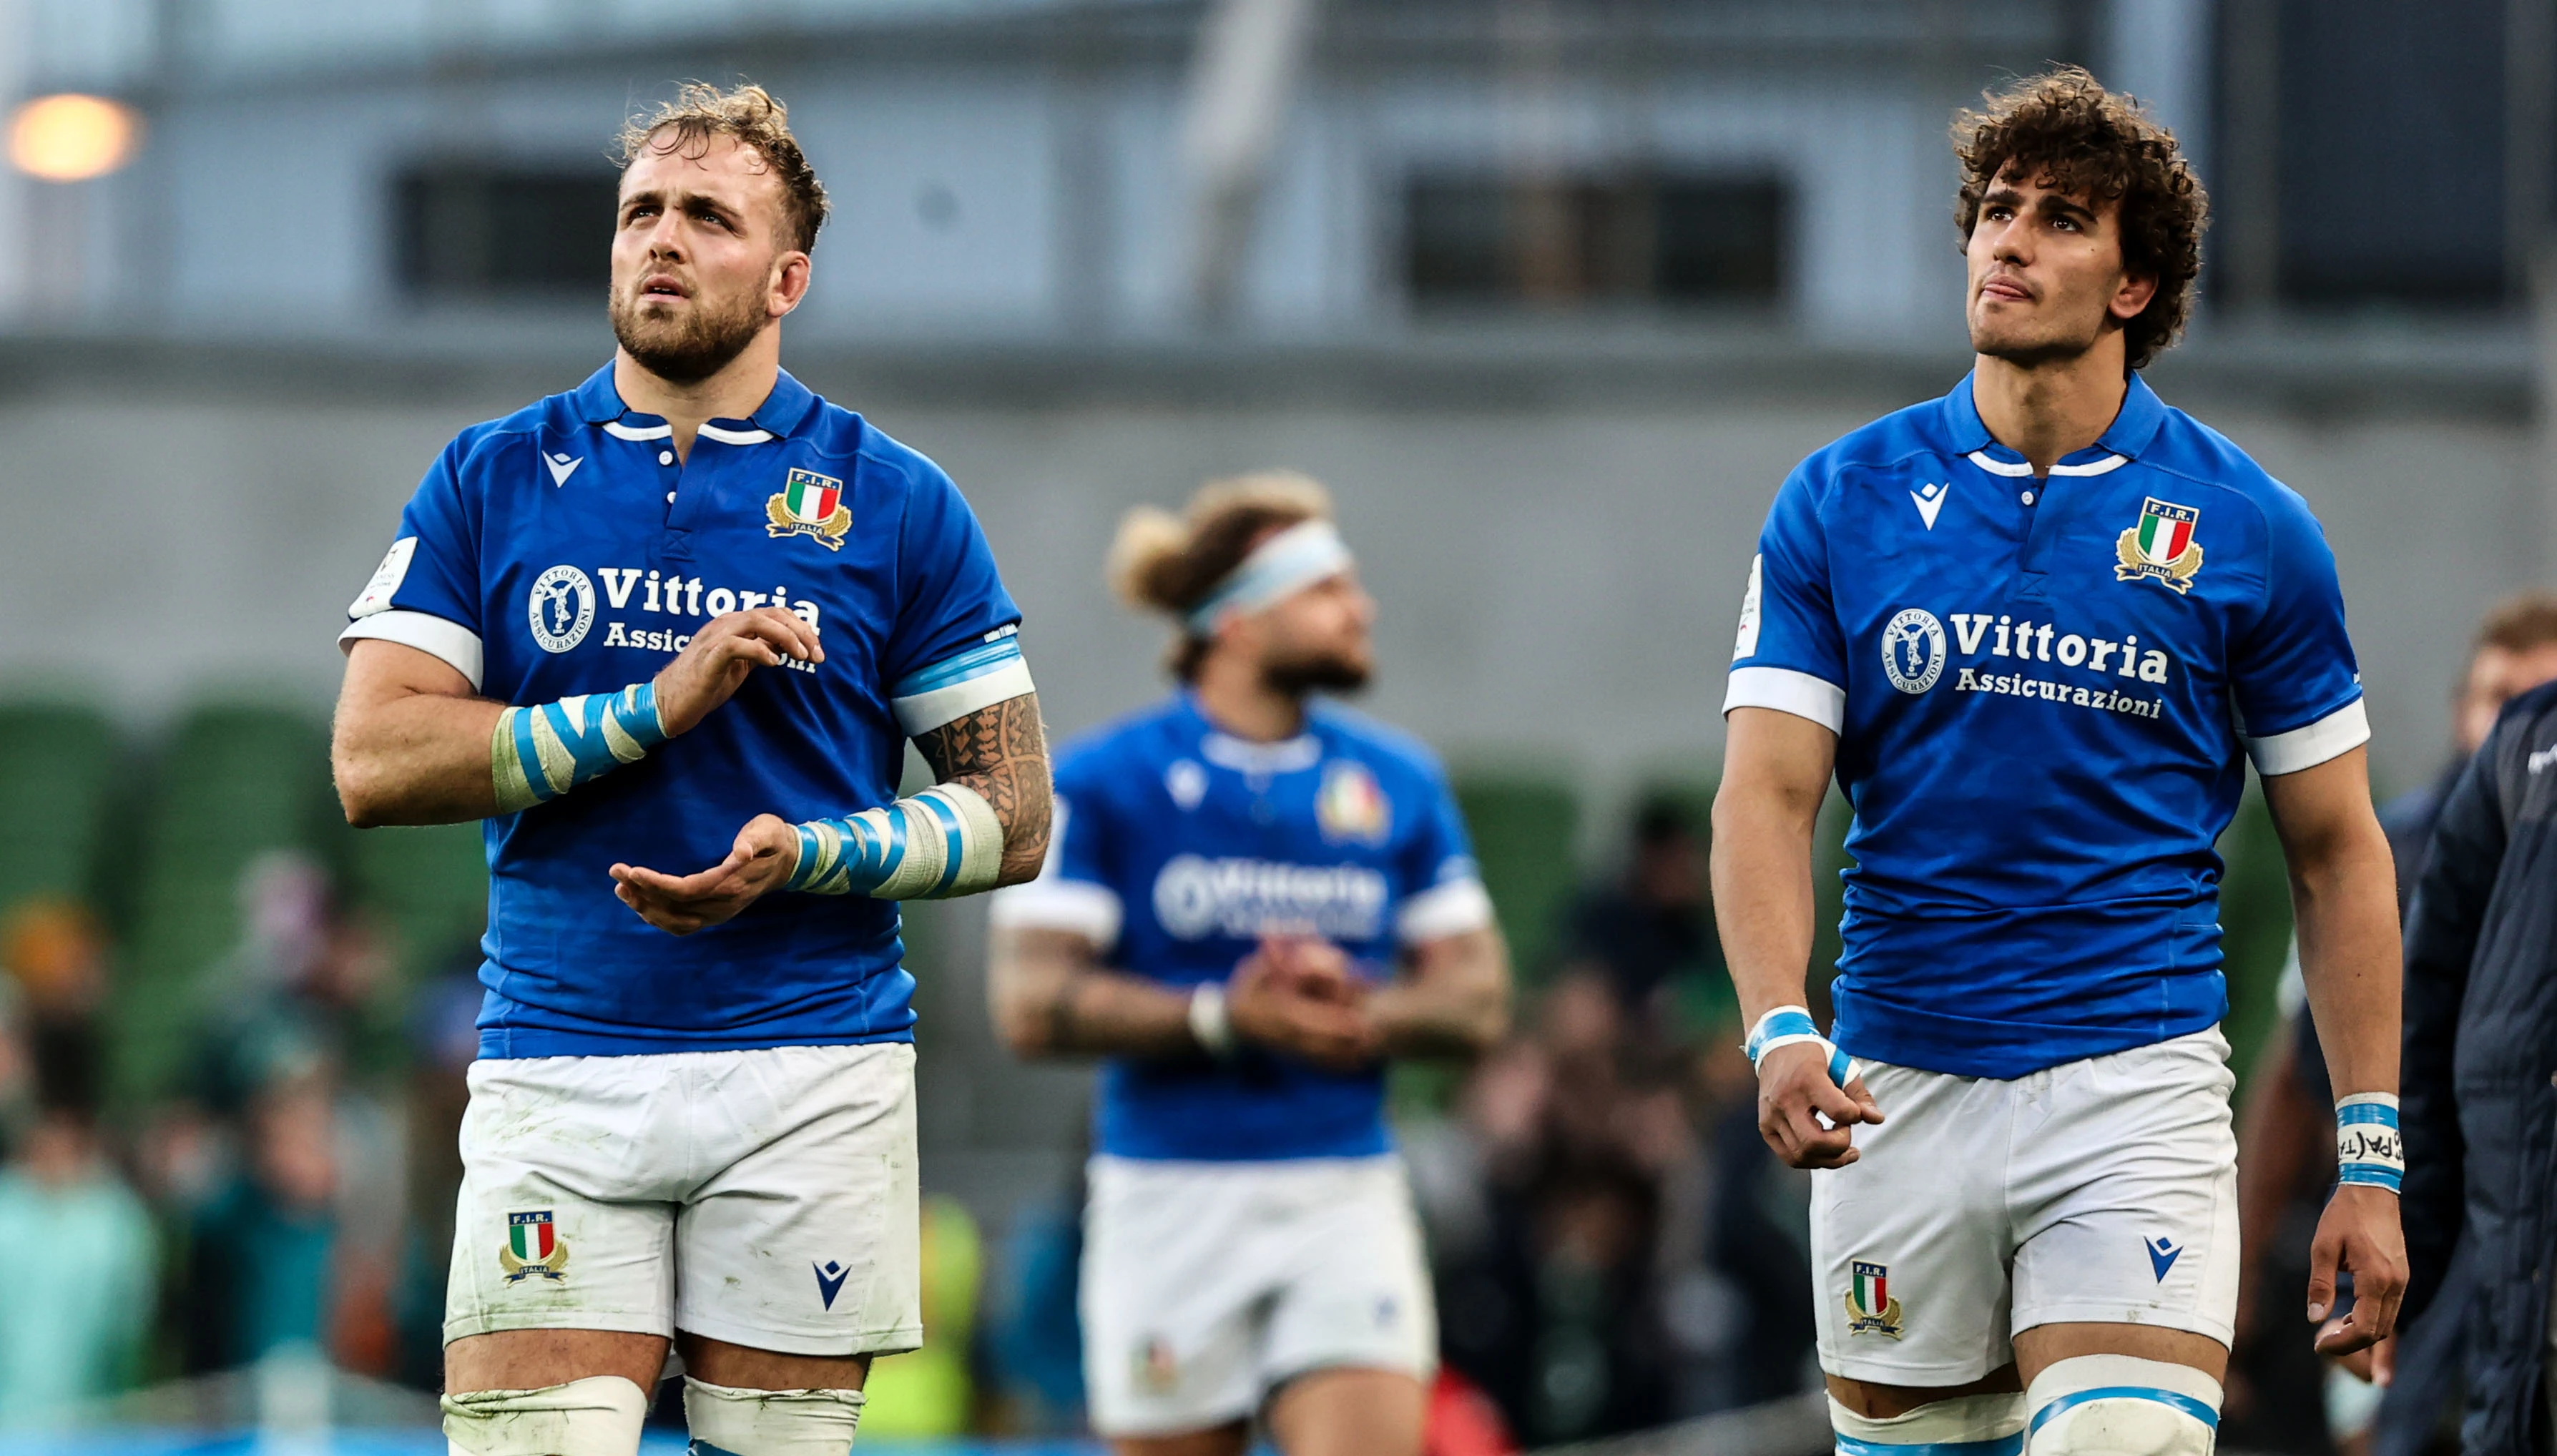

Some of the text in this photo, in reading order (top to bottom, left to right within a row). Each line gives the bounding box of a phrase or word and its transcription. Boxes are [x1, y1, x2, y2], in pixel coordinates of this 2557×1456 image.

[795, 473, 836, 489] F.I.R.
[2150, 503, 2190, 521] F.I.R.
[790, 523, 823, 536] ITALIA
[2139, 564, 2171, 578] ITALIA
[535, 569, 587, 595] VITTORIA
[1888, 613, 1939, 636] VITTORIA
[1950, 614, 2168, 684] Vittoria
[1955, 668, 2162, 719] Assicurazioni
[514, 1214, 549, 1224] F.I.R.
[1856, 1264, 1883, 1277] F.I.R.
